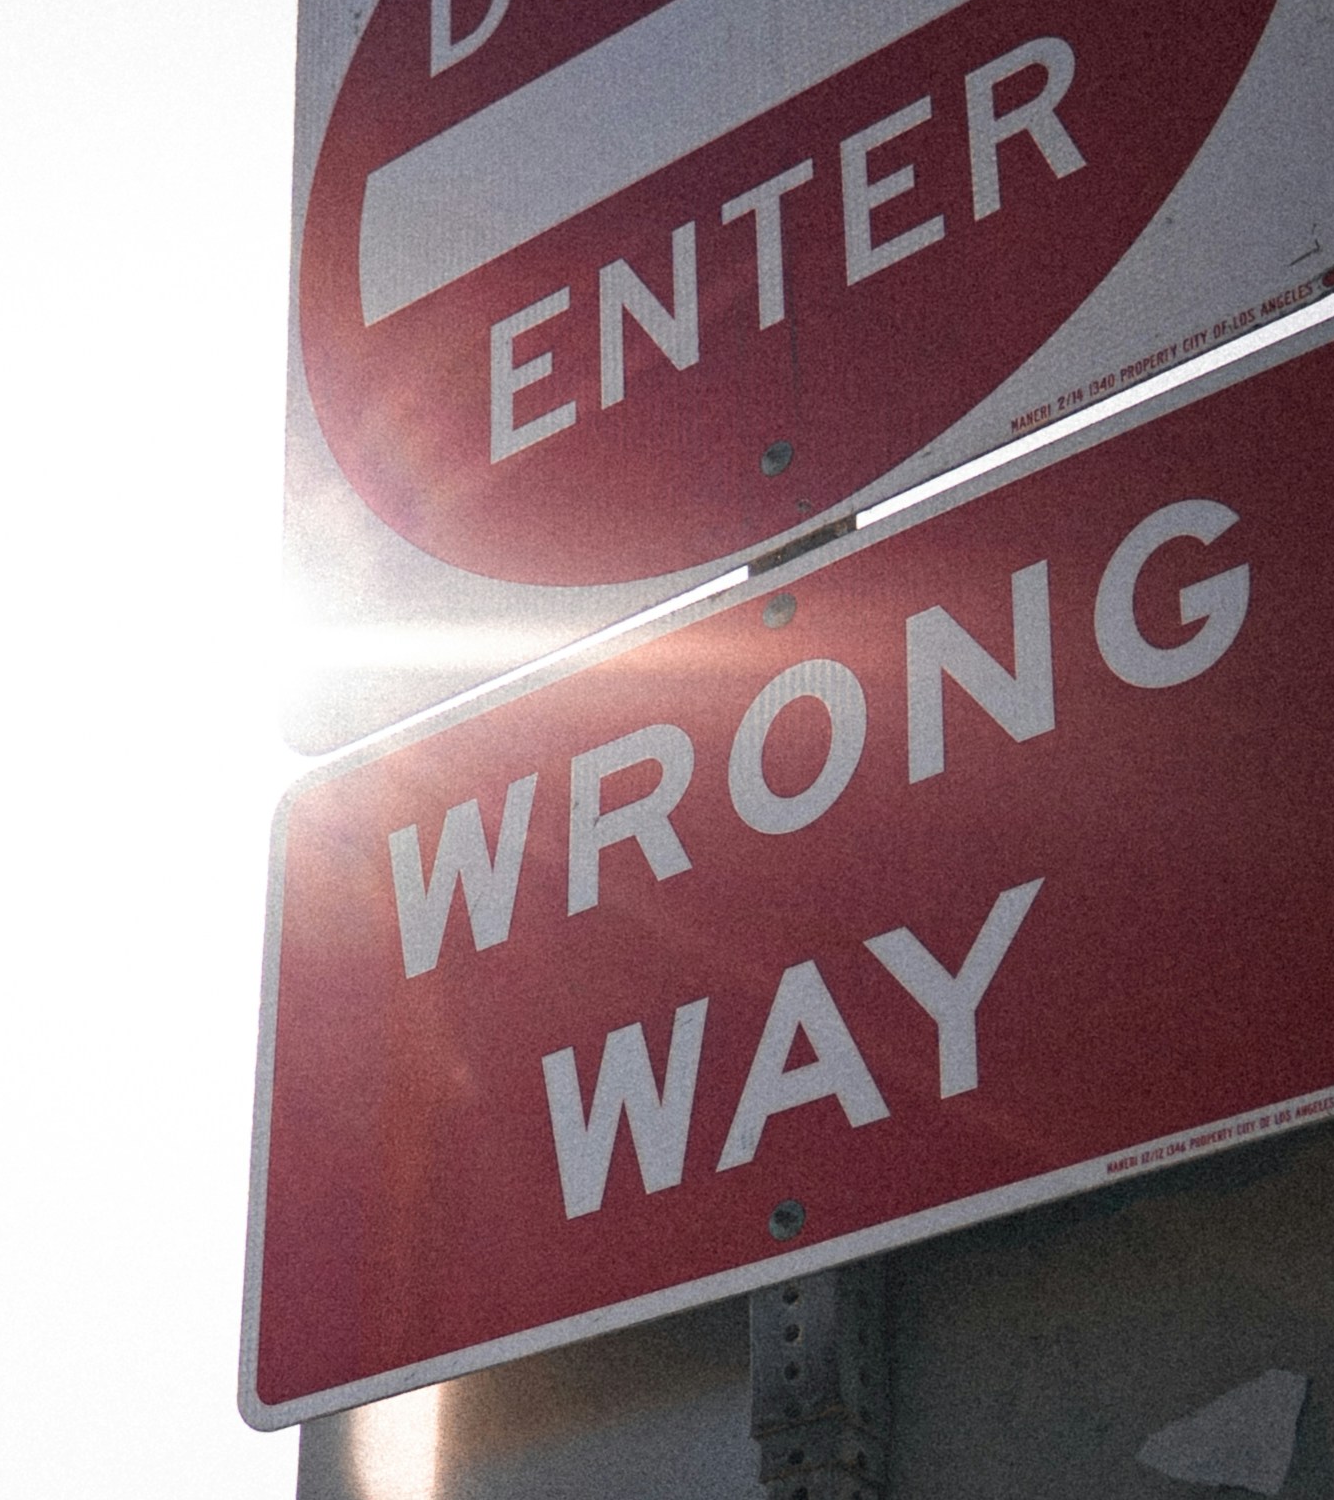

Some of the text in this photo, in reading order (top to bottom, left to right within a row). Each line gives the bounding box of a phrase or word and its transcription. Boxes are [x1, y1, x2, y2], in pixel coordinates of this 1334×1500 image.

[488, 36, 1088, 465] ENTER
[1120, 344, 1178, 382] PROPERTY
[1182, 329, 1209, 352] CITY
[1213, 319, 1228, 339] OF
[1232, 308, 1256, 331] LOS
[1260, 280, 1314, 317] ANGELES
[385, 497, 1252, 980] WRONG
[540, 875, 1047, 1221] WAY
[1274, 1108, 1292, 1126] LOS
